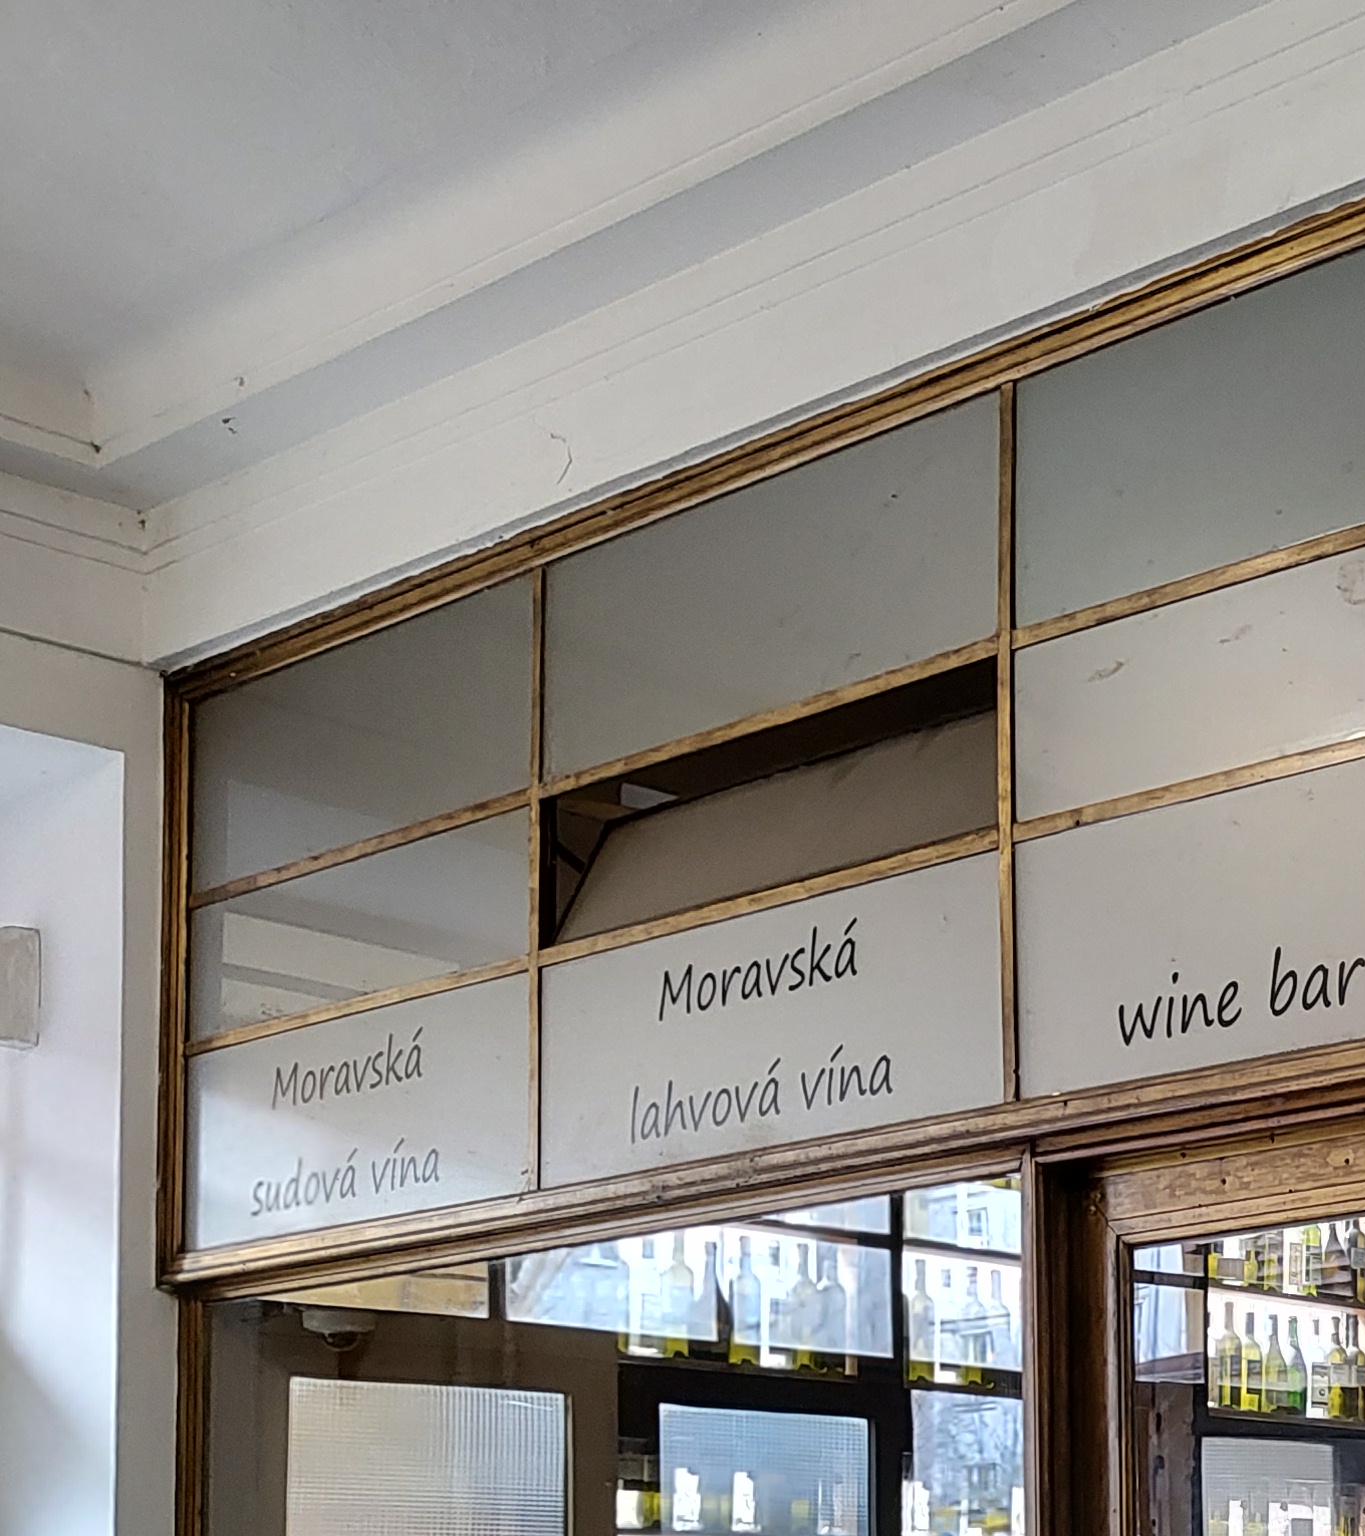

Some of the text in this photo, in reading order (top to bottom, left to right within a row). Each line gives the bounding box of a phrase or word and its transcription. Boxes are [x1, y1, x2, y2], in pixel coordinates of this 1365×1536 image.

[658, 917, 858, 1022] Moravská
[1118, 946, 1365, 1047] wine bar
[271, 1026, 424, 1109] Moravská
[630, 1044, 894, 1144] lahvová vína
[250, 1137, 440, 1217] sudová vína
